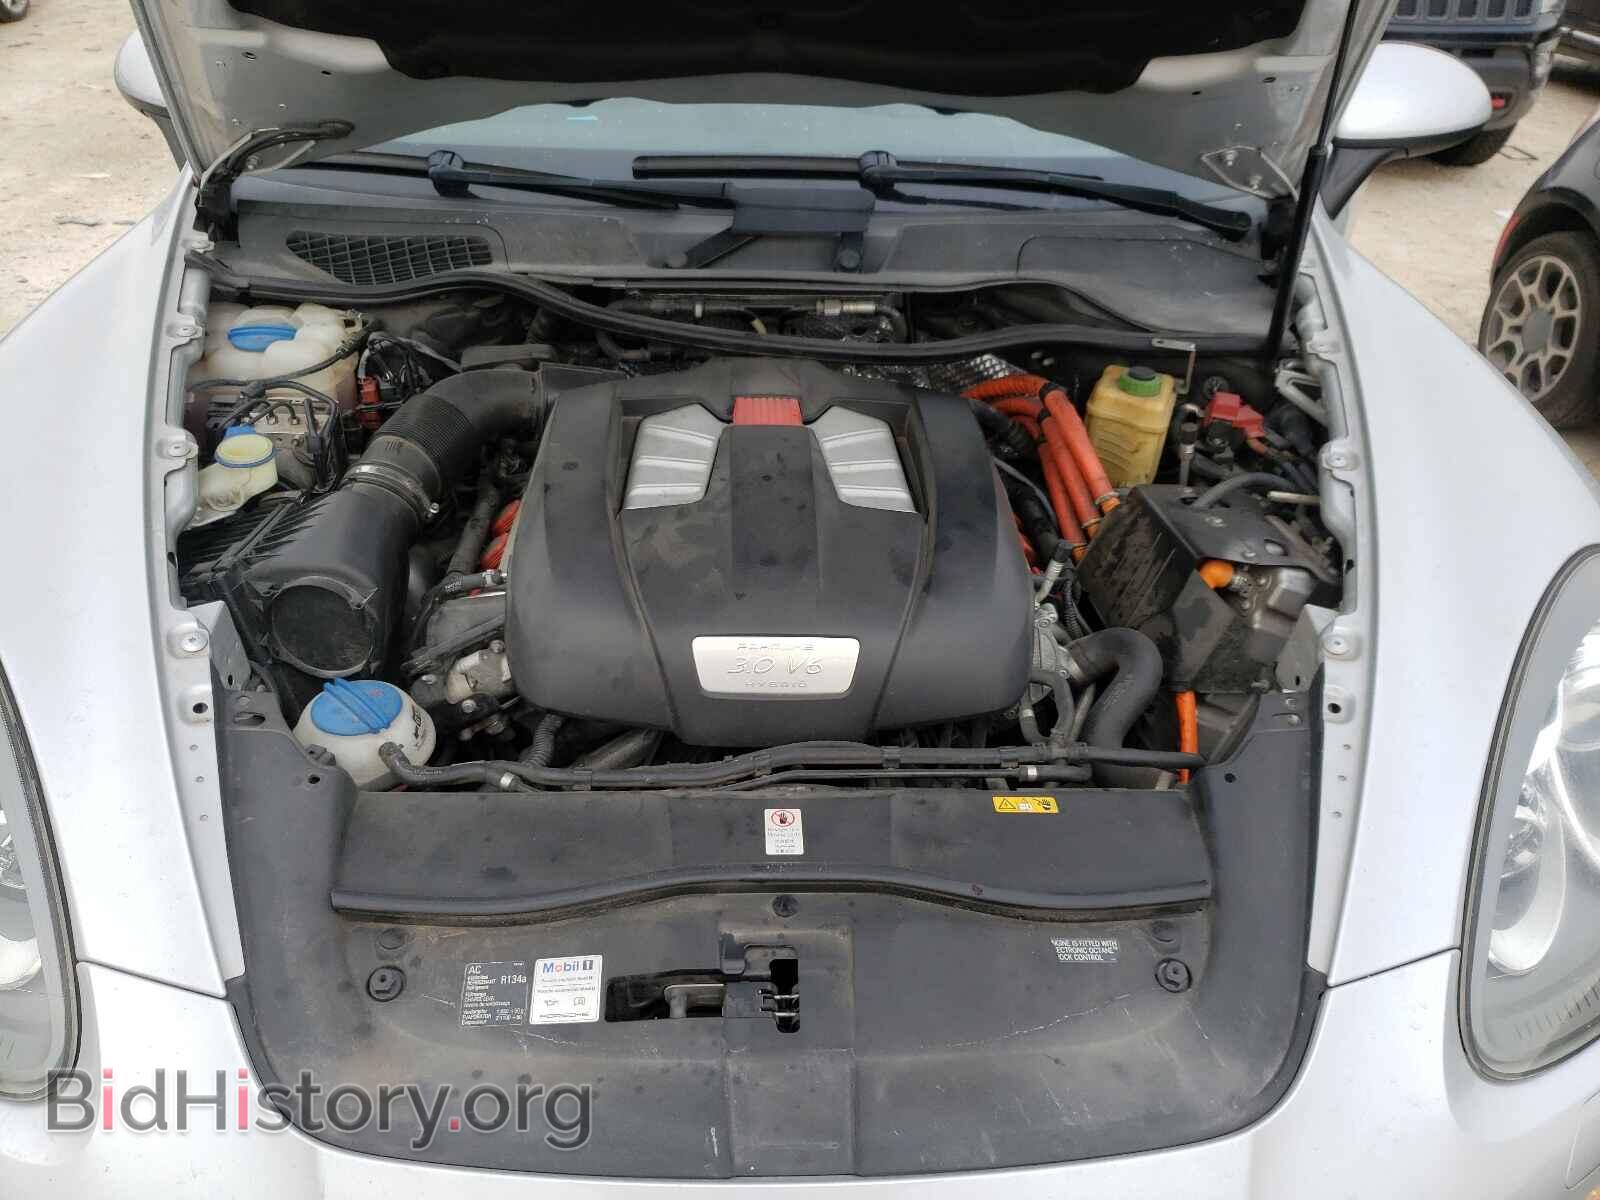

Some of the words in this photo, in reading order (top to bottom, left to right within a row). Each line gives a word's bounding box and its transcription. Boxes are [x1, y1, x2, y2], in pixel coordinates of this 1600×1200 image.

[727, 656, 776, 675] 3.0
[787, 655, 823, 675] V6
[1074, 953, 1104, 961] CONTROL
[468, 965, 482, 975] AC
[543, 960, 580, 975] Mobil
[500, 974, 527, 985] R134a
